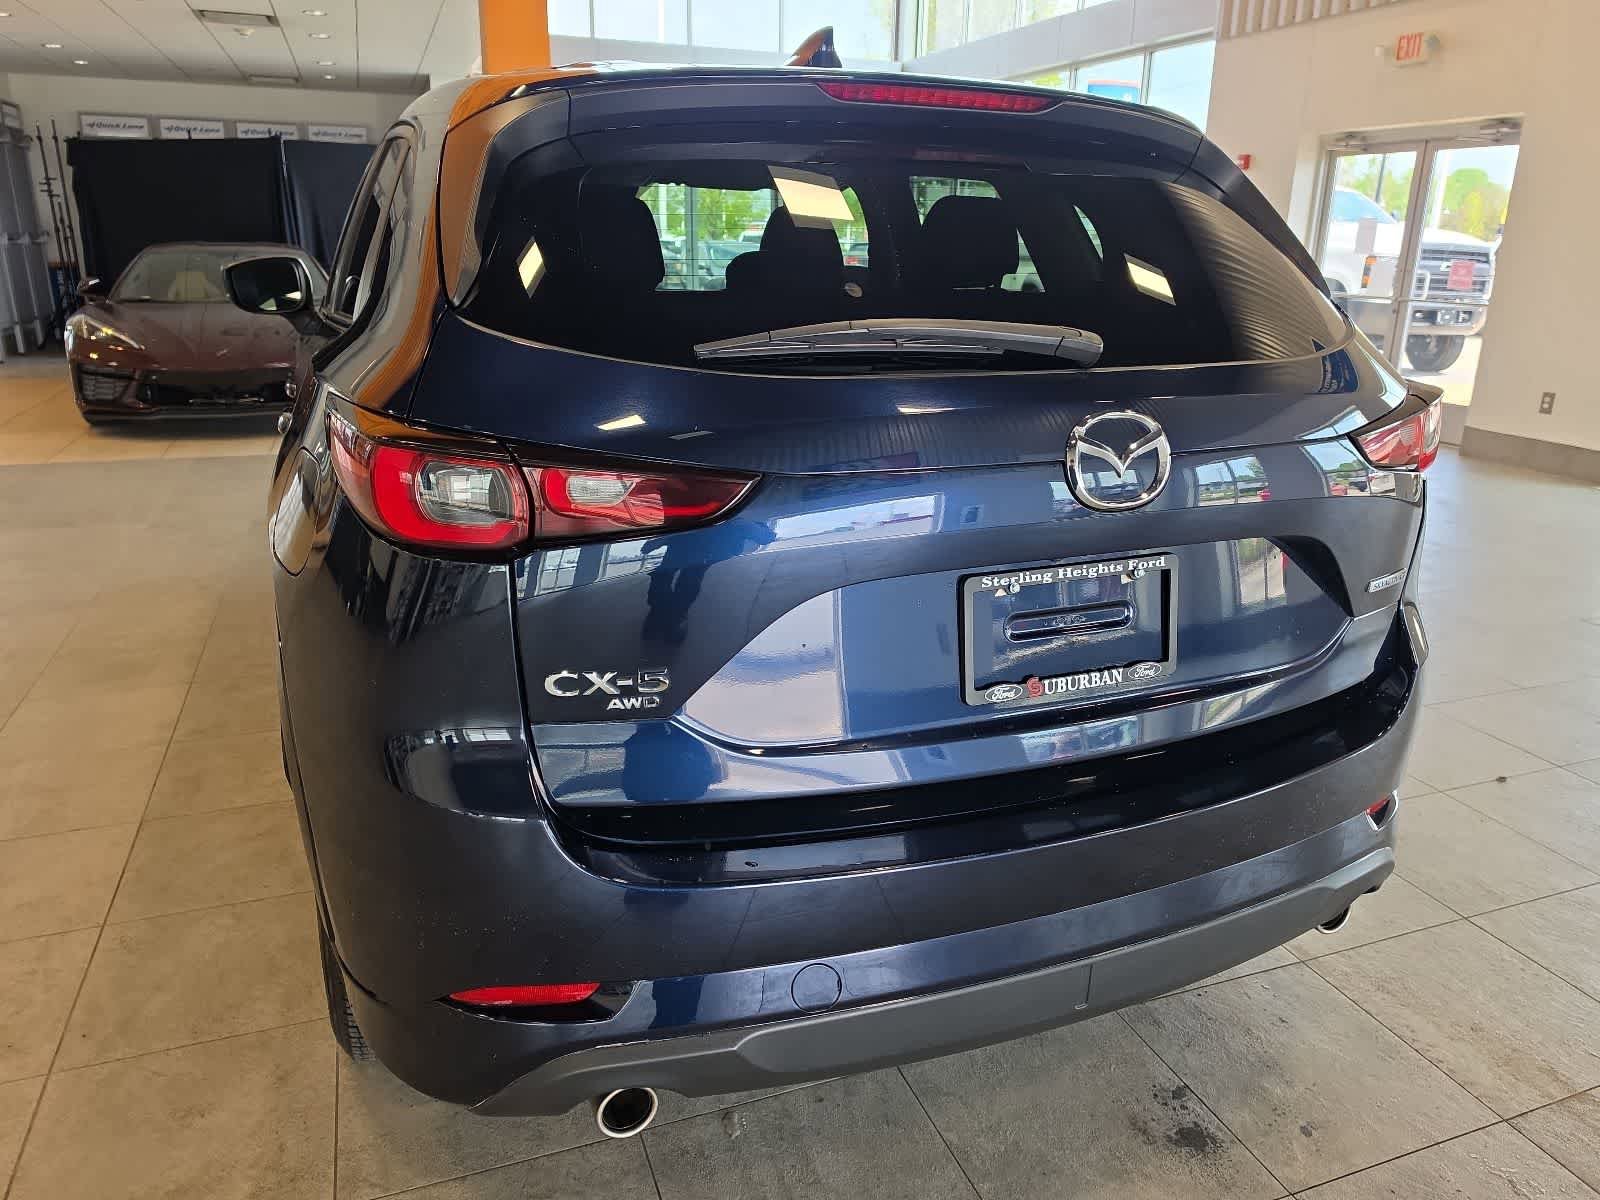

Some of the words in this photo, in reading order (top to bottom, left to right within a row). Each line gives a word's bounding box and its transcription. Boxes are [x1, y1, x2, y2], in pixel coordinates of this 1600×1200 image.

[1396, 33, 1424, 61] EXIT
[981, 571, 1053, 588] Sterling
[1057, 562, 1123, 579] Heights
[1127, 556, 1166, 571] Ford
[544, 667, 669, 697] CX-5
[987, 684, 1019, 701] Ford
[1027, 668, 1124, 699] SUBURBAN
[1131, 662, 1160, 679] Ford
[606, 696, 660, 711] AWD
